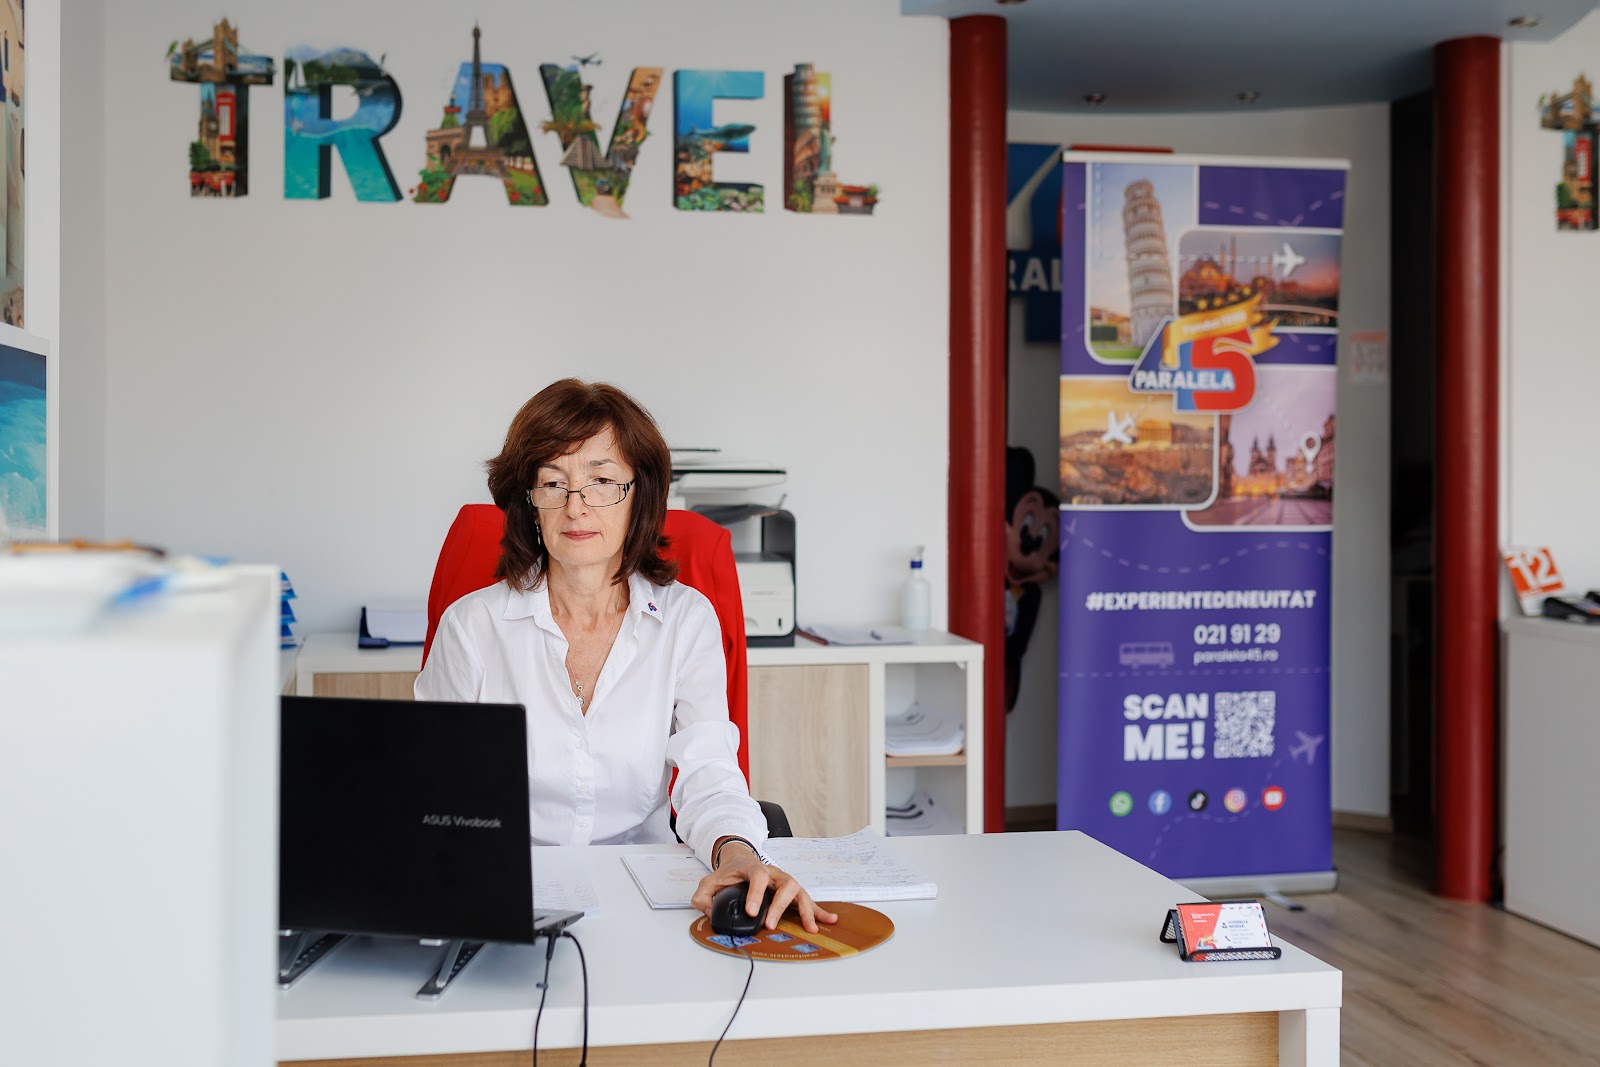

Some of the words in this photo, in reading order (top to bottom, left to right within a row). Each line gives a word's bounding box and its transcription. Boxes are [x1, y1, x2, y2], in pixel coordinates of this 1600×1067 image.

[167, 16, 879, 218] TRAVEL
[1134, 369, 1235, 391] PARALELA
[1508, 549, 1561, 590] 12
[1085, 590, 1316, 610] #EXPERIENTEDENEUITAT
[1193, 624, 1227, 645] 021
[1230, 623, 1251, 644] 91
[1254, 622, 1281, 644] 29
[1193, 647, 1279, 666] paralela45.ro
[1123, 693, 1209, 720] SCAN
[1123, 721, 1206, 762] ME!
[422, 814, 451, 826] ASUS
[453, 815, 501, 828] Vivobook
